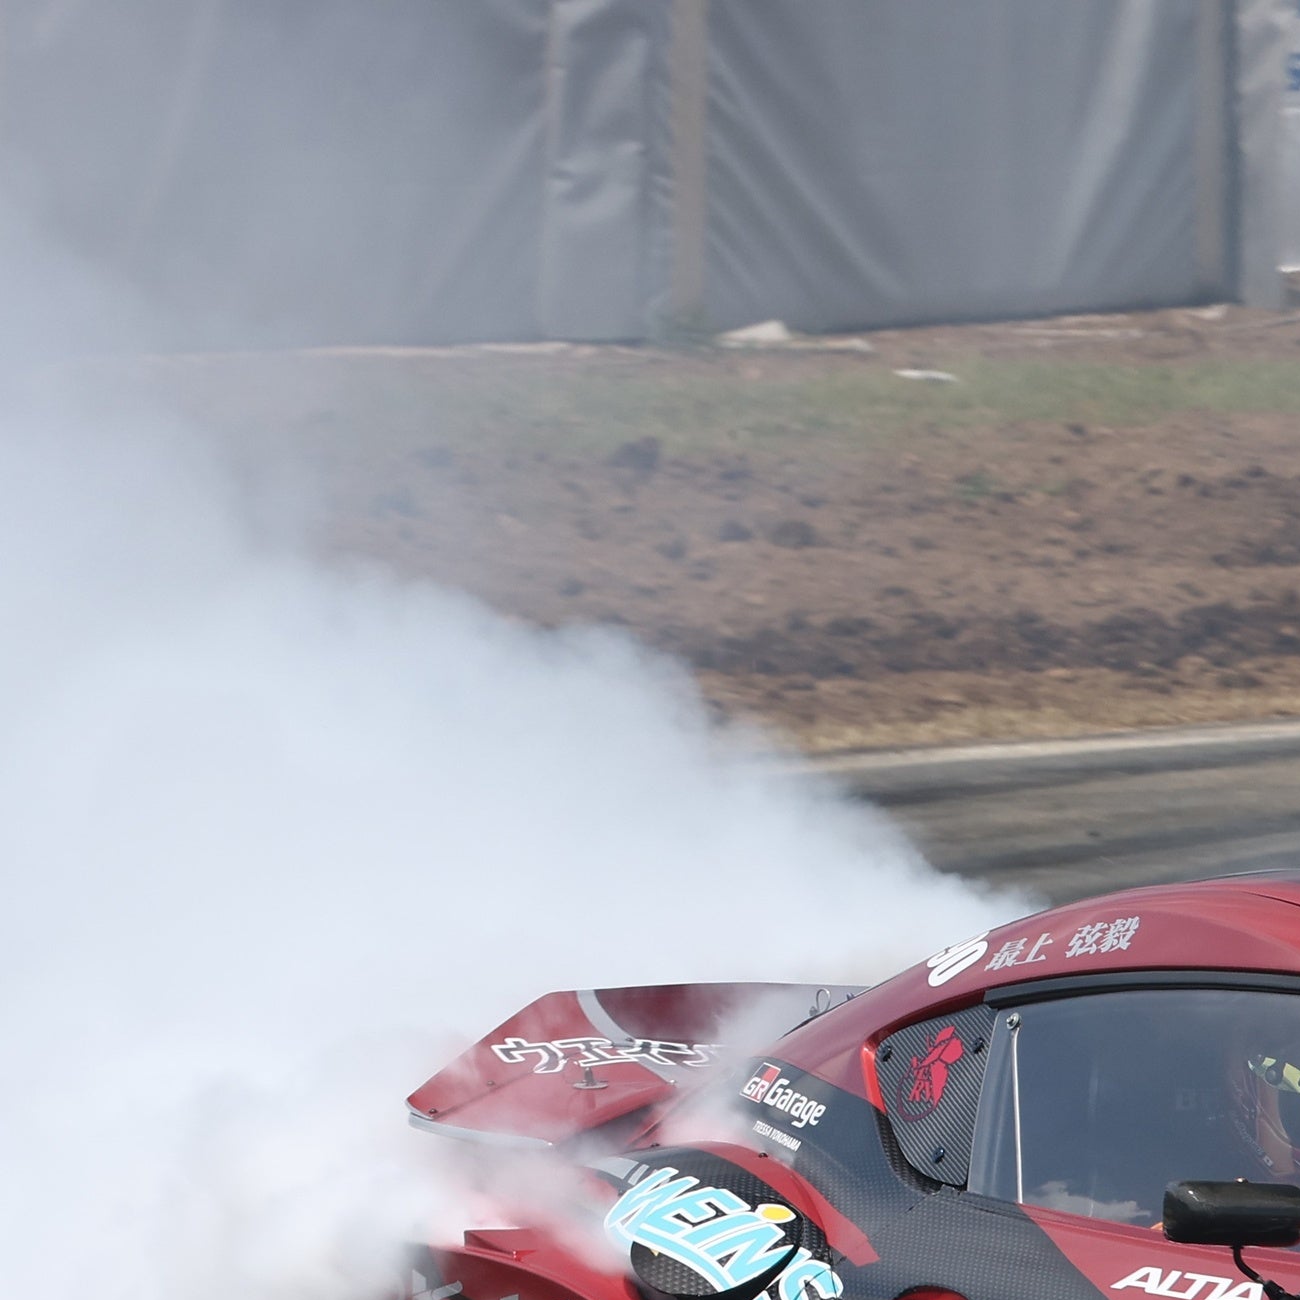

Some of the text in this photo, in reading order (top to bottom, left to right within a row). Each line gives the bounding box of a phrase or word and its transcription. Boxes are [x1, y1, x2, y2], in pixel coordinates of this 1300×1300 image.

[984, 933, 1053, 971] 最上
[743, 1076, 827, 1128] GR Garage
